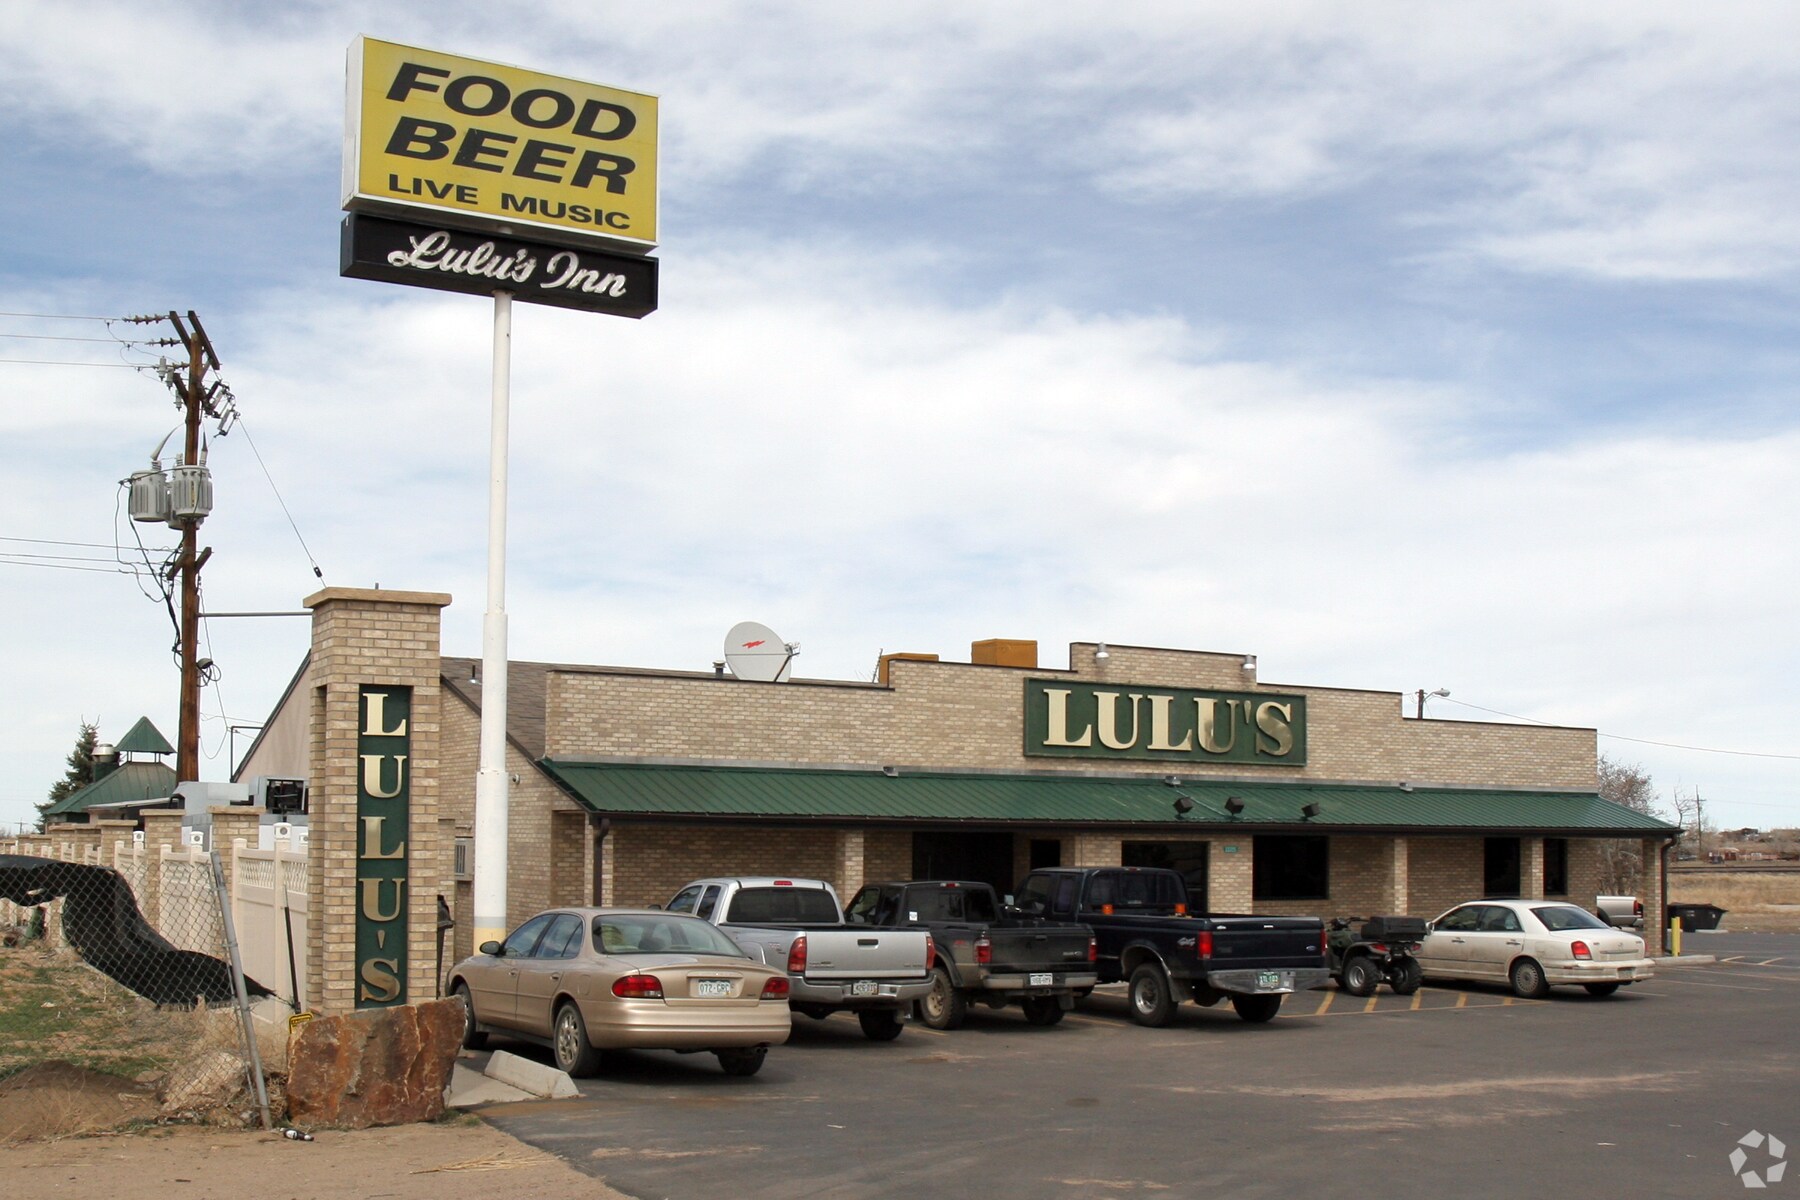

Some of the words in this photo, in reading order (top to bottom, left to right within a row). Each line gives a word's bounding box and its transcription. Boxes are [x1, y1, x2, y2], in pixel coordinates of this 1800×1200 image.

[386, 62, 636, 141] FOOD
[384, 116, 636, 195] BEER
[389, 174, 478, 204] LIVE
[501, 193, 630, 229] MUSIC
[387, 231, 537, 282] Lulu's
[540, 251, 626, 297] Inn
[1043, 688, 1293, 756] LULU'S
[358, 693, 407, 1002] LULU'S
